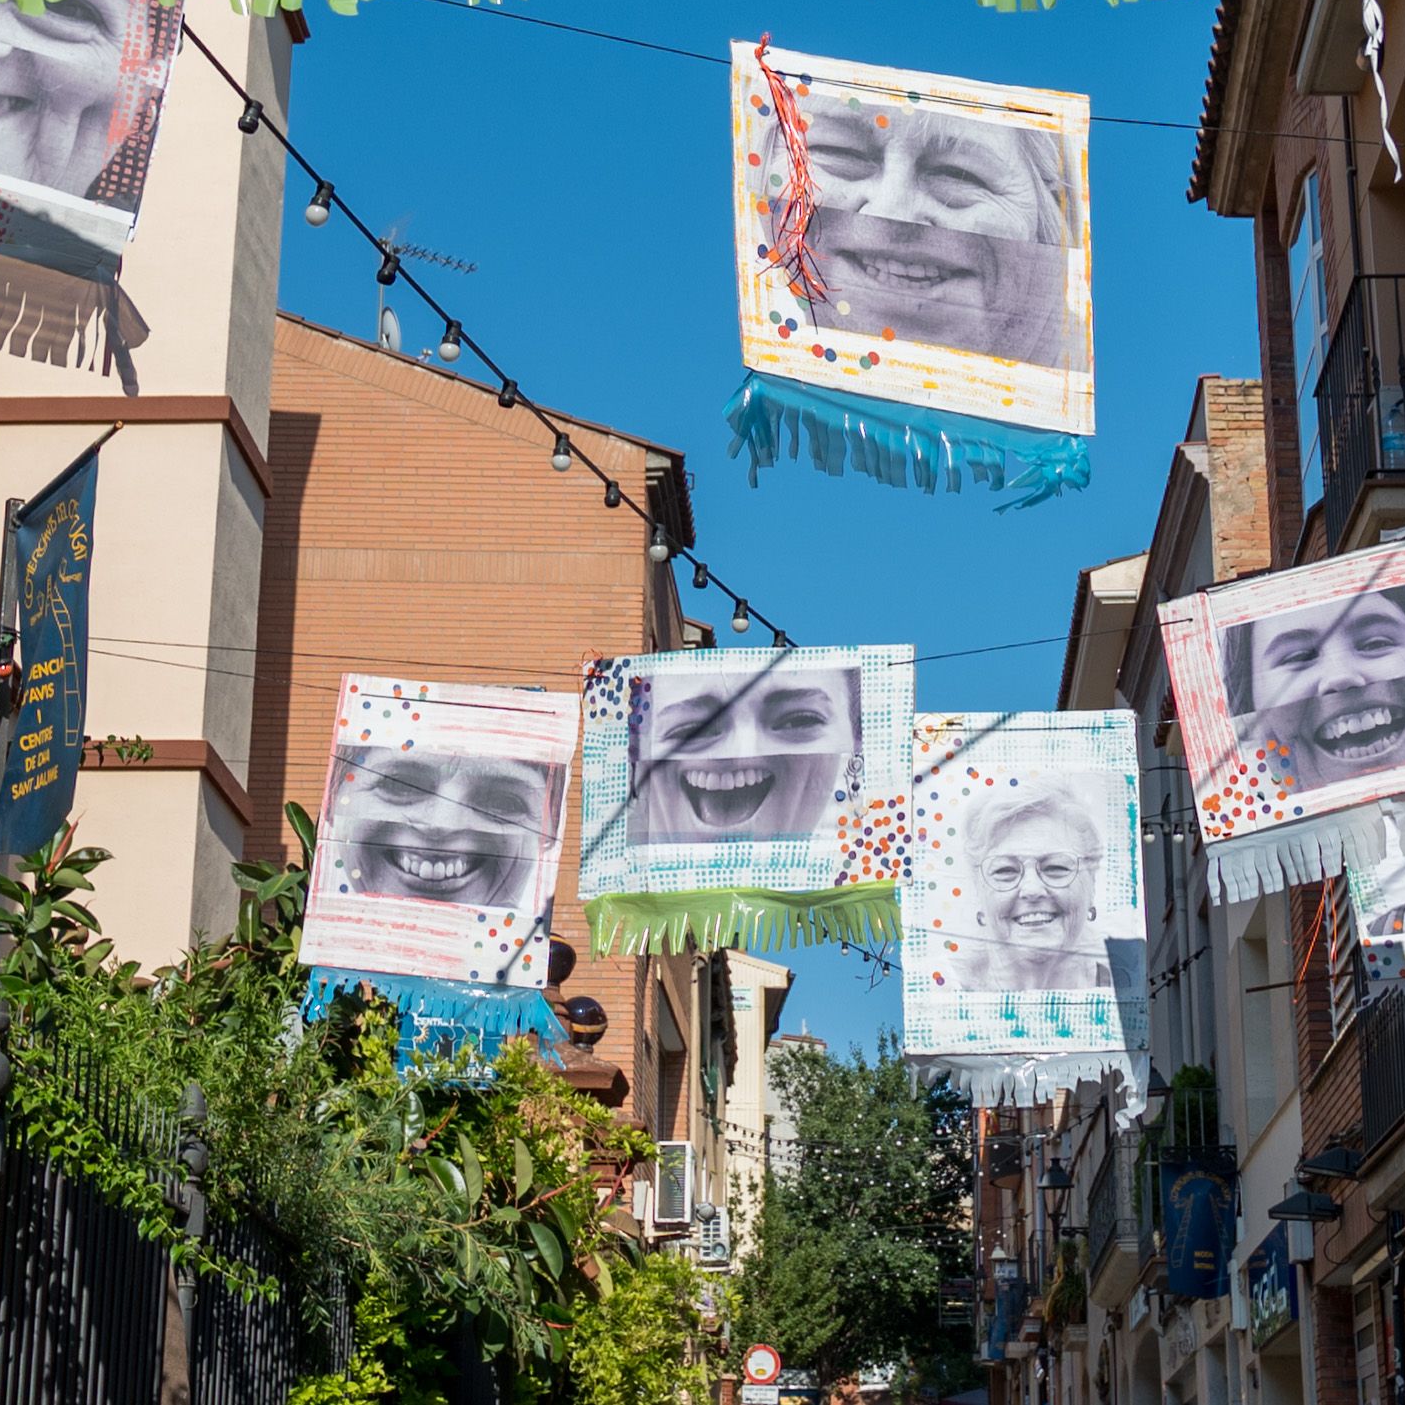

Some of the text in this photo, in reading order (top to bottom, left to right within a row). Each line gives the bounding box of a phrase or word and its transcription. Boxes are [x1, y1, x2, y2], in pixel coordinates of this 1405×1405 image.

[27, 656, 65, 682] ENCIA
[19, 724, 54, 752] CENTRE
[25, 754, 36, 773] DE
[11, 777, 34, 801] SANT
